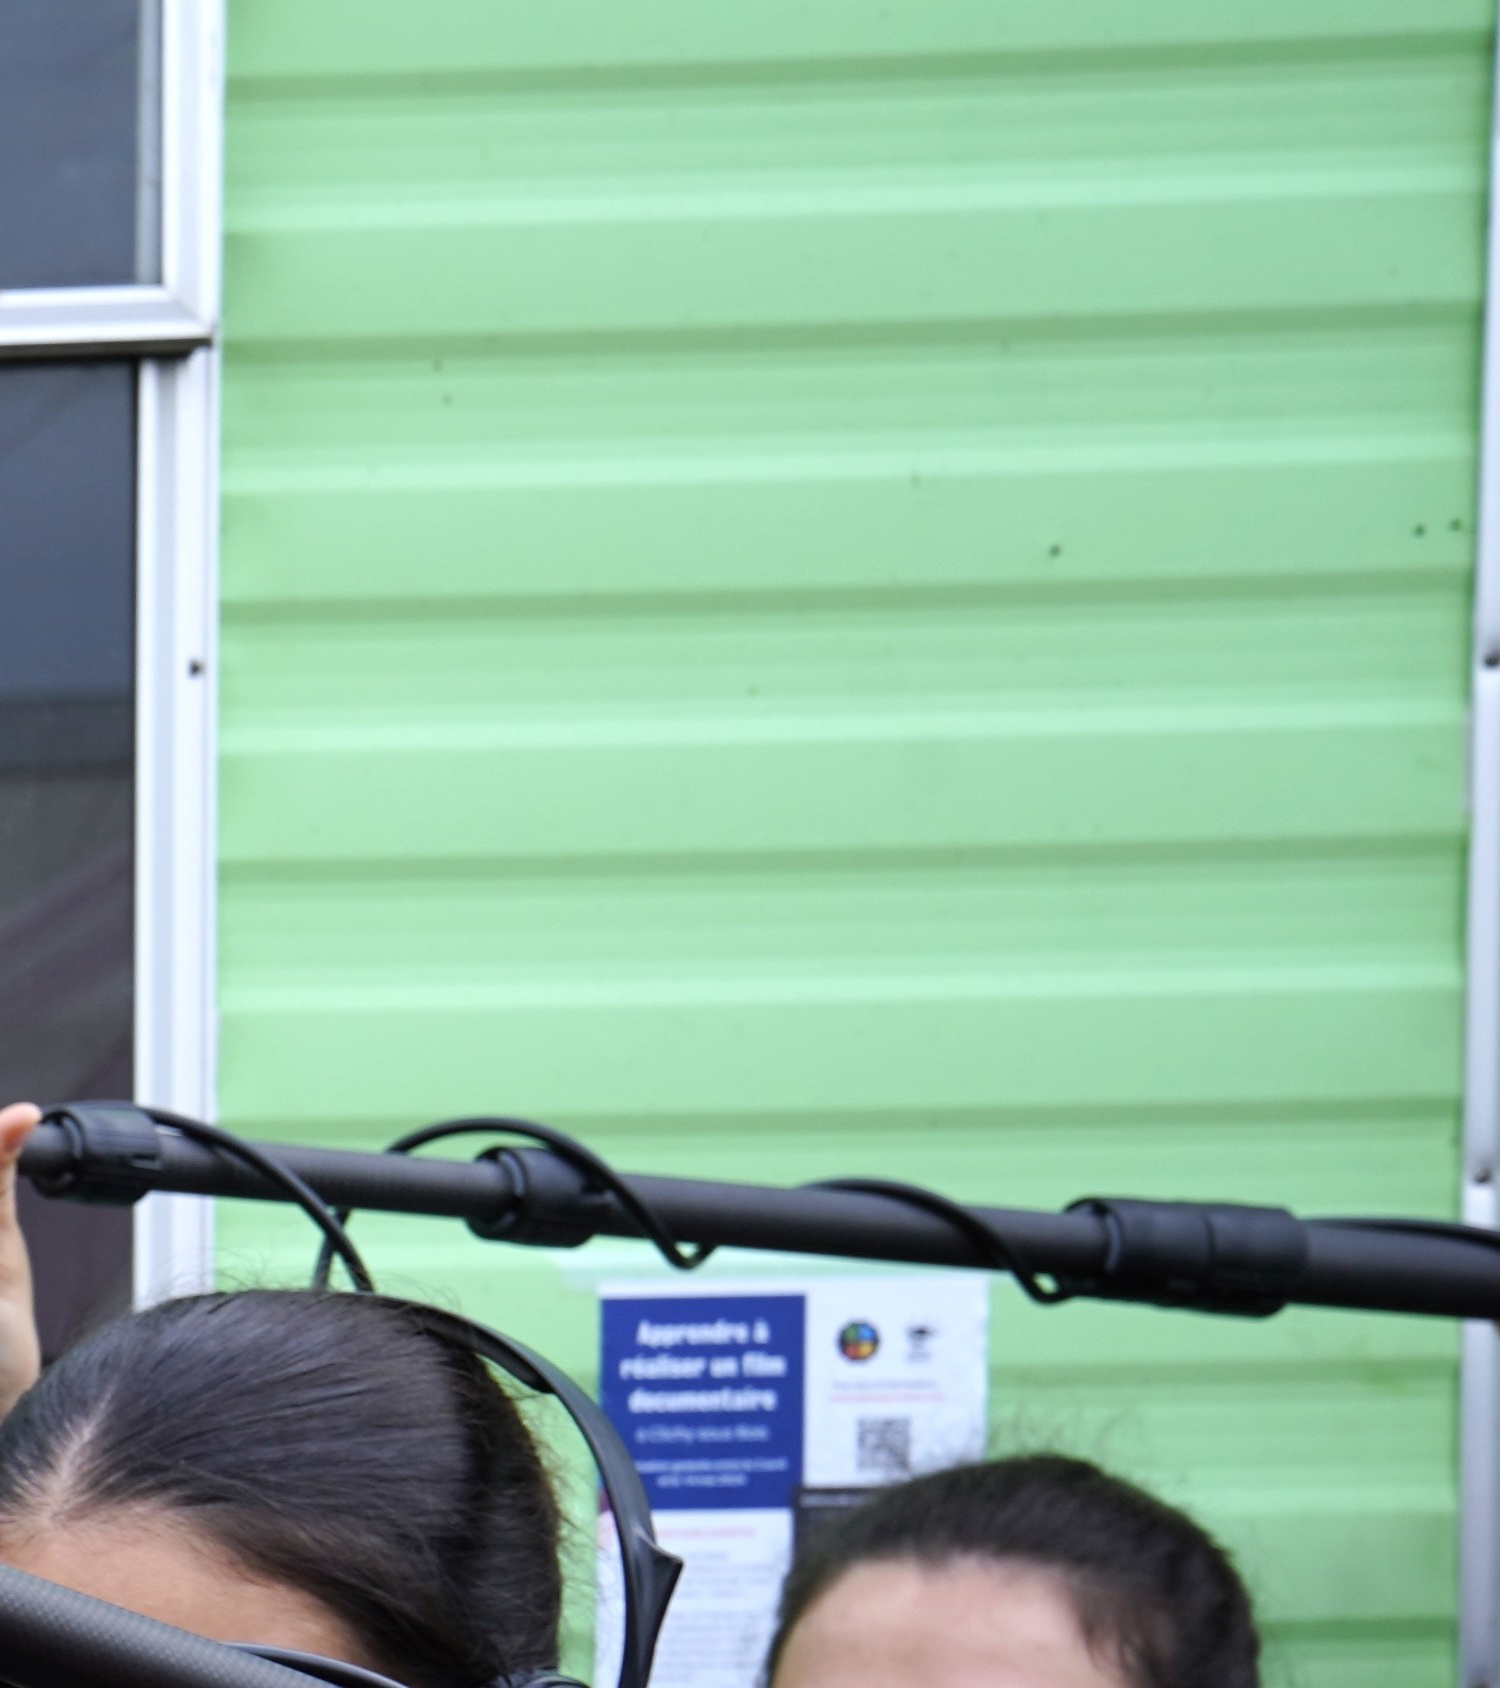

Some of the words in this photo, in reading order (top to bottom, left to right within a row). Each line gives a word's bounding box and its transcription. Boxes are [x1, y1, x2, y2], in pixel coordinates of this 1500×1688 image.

[637, 1320, 749, 1348] Apprendre
[752, 1318, 770, 1344] à
[619, 1353, 706, 1380] réaliser
[710, 1356, 739, 1378] un
[742, 1350, 787, 1377] film
[628, 1386, 778, 1413] documentaire
